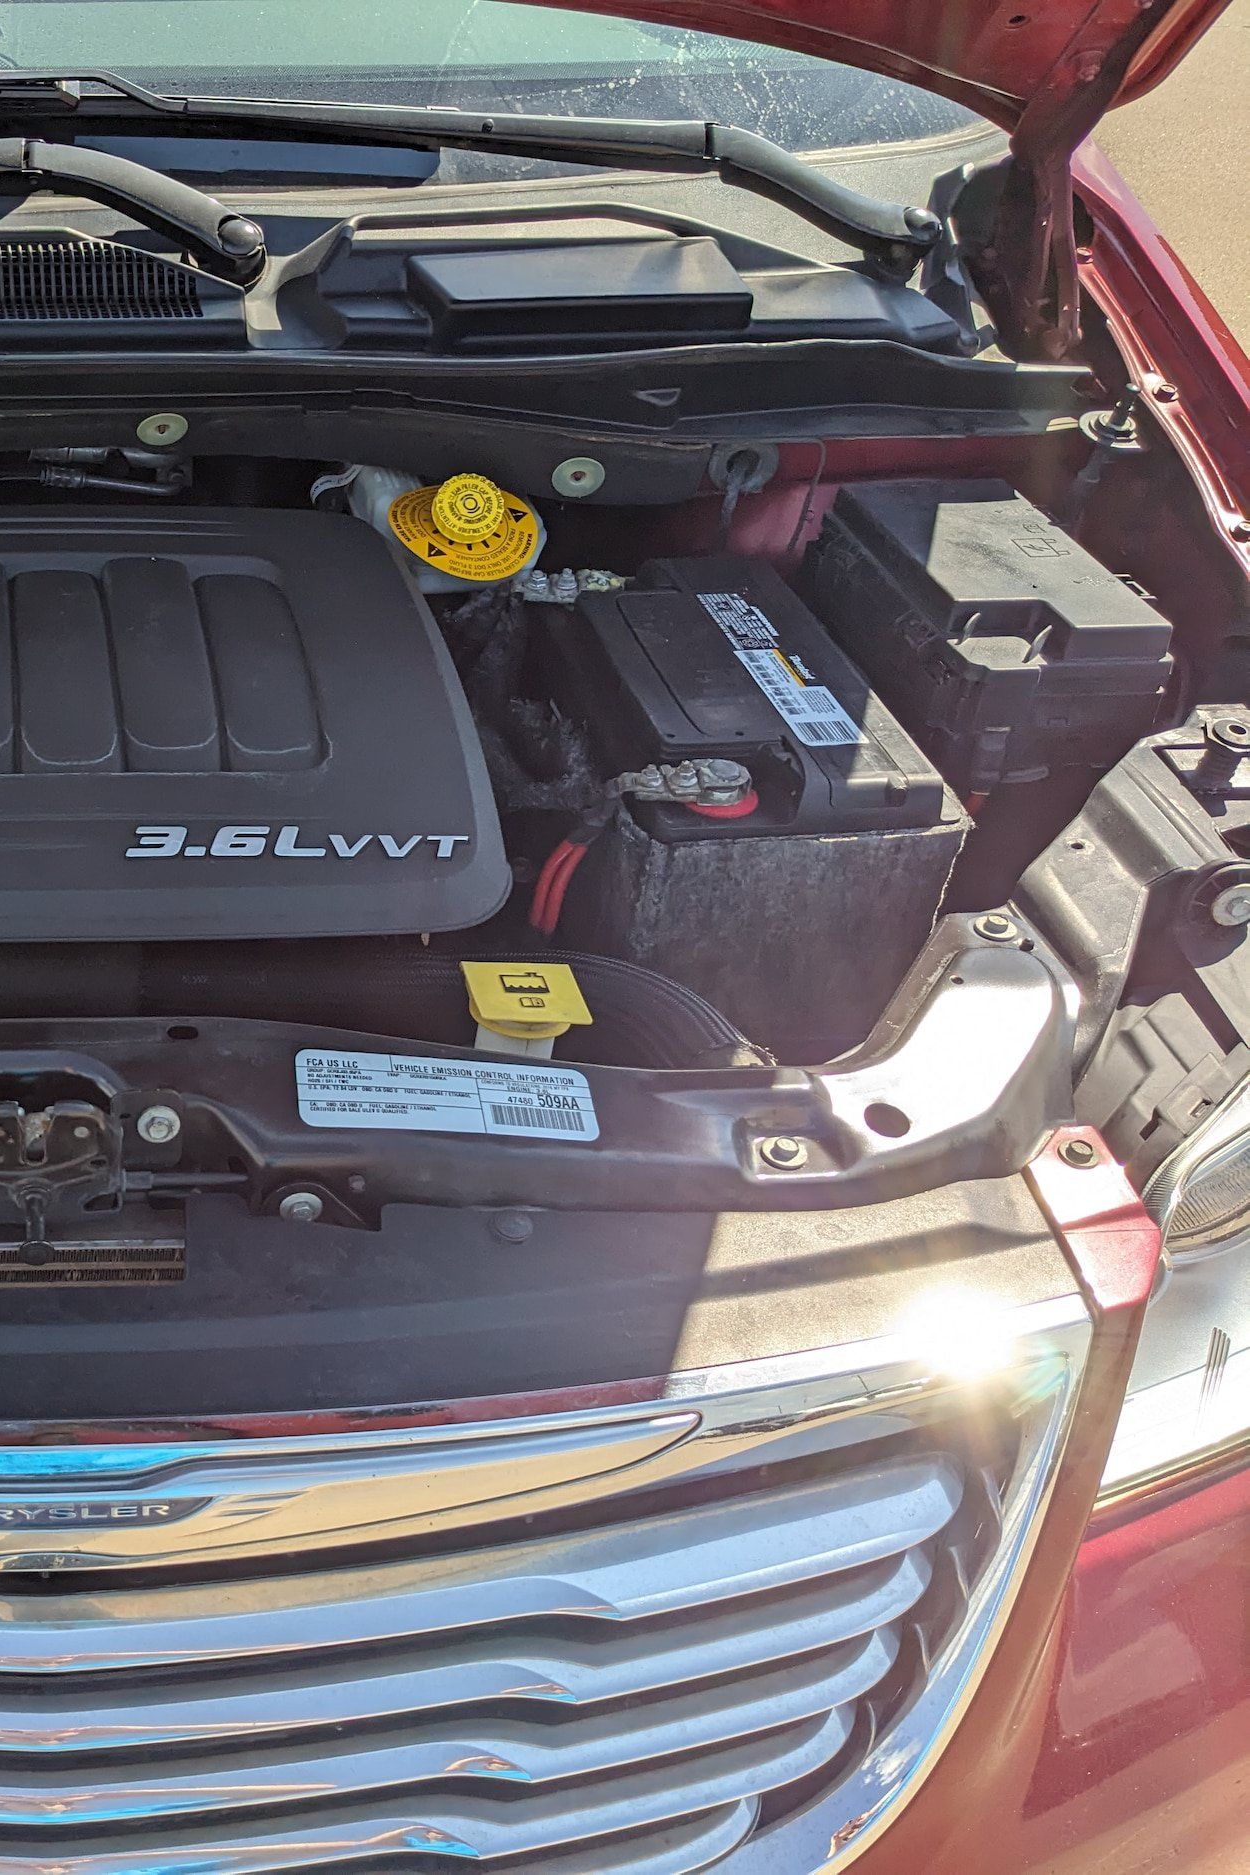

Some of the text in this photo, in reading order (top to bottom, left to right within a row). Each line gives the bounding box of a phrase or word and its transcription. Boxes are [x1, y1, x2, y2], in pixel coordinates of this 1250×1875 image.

[491, 545, 508, 558] SEALED
[488, 560, 501, 569] ONLY
[504, 559, 519, 571] CLEAN
[125, 825, 470, 858] 3.6L VVT
[306, 1058, 358, 1068] FCA US LLC
[394, 1064, 574, 1085] VEHICLE EMISSION CONTROL INFORMATION
[538, 1094, 580, 1110] 509AA
